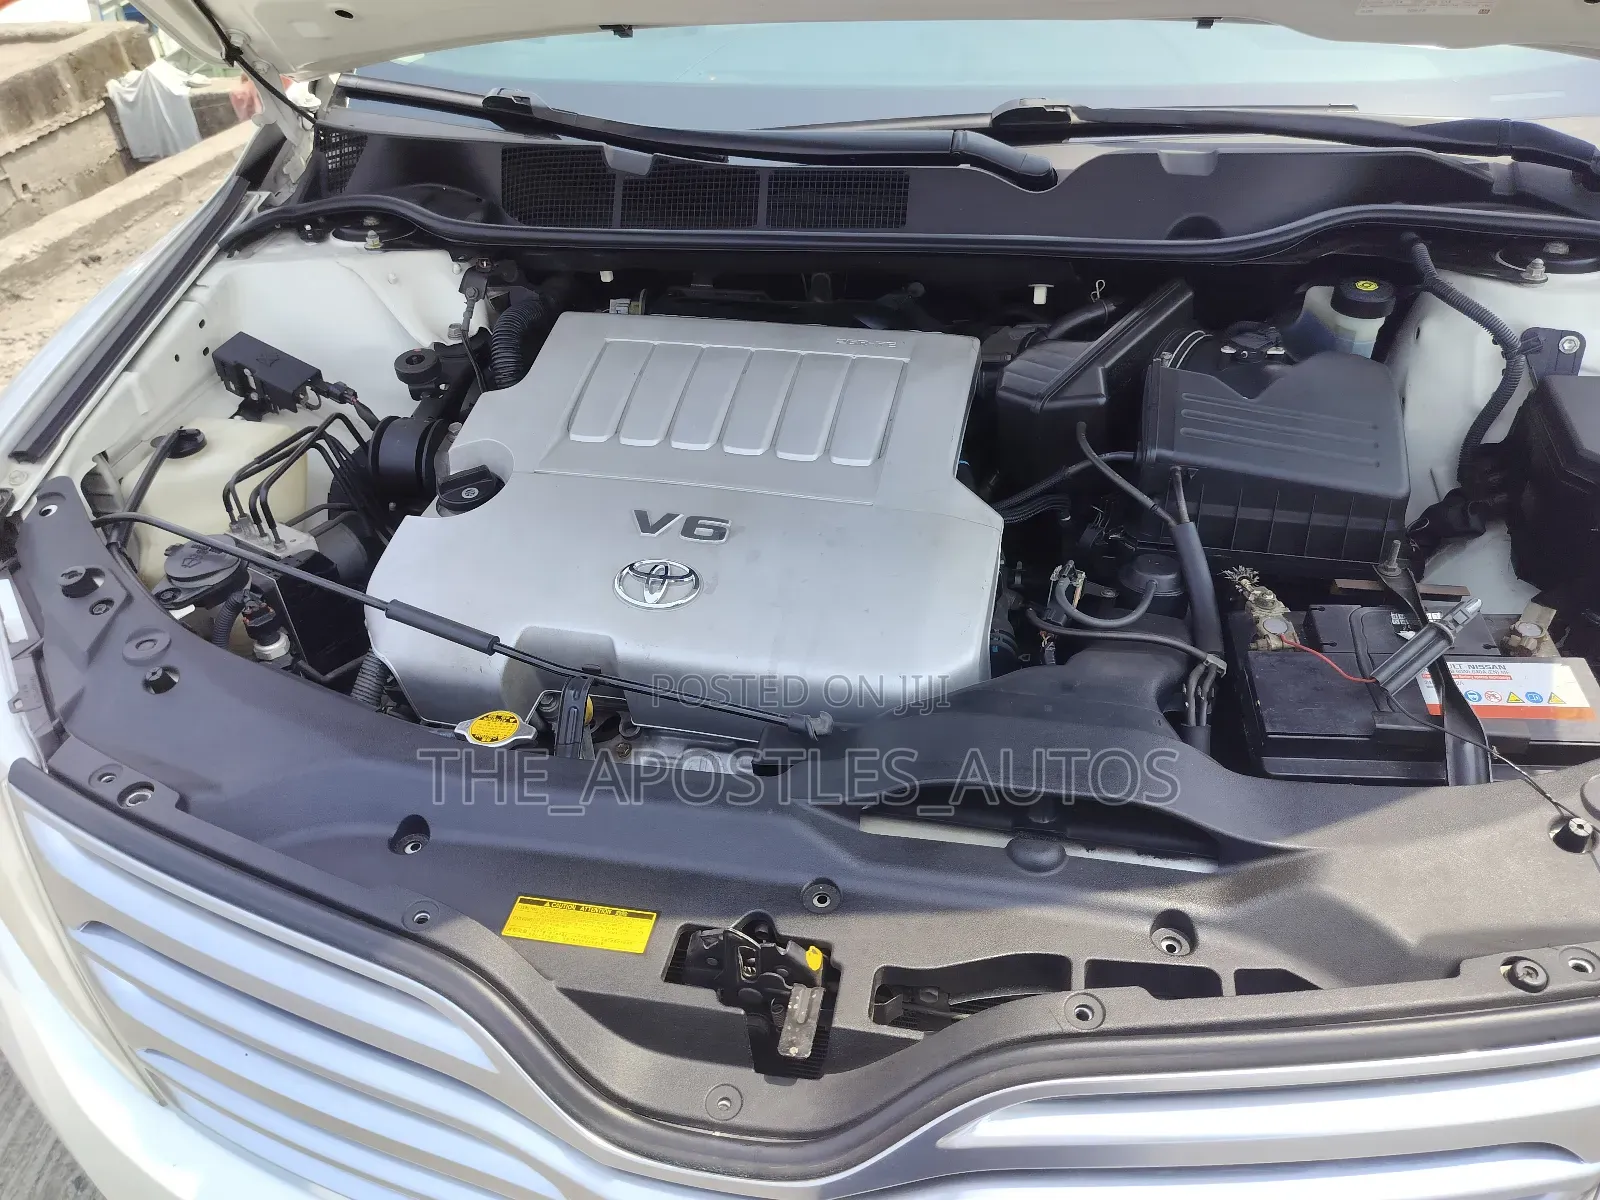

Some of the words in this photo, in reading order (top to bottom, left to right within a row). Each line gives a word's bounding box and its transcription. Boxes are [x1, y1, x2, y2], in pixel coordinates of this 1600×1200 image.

[632, 509, 732, 543] V6
[551, 902, 577, 911] CAUTION
[579, 905, 613, 915] ATTENTION
